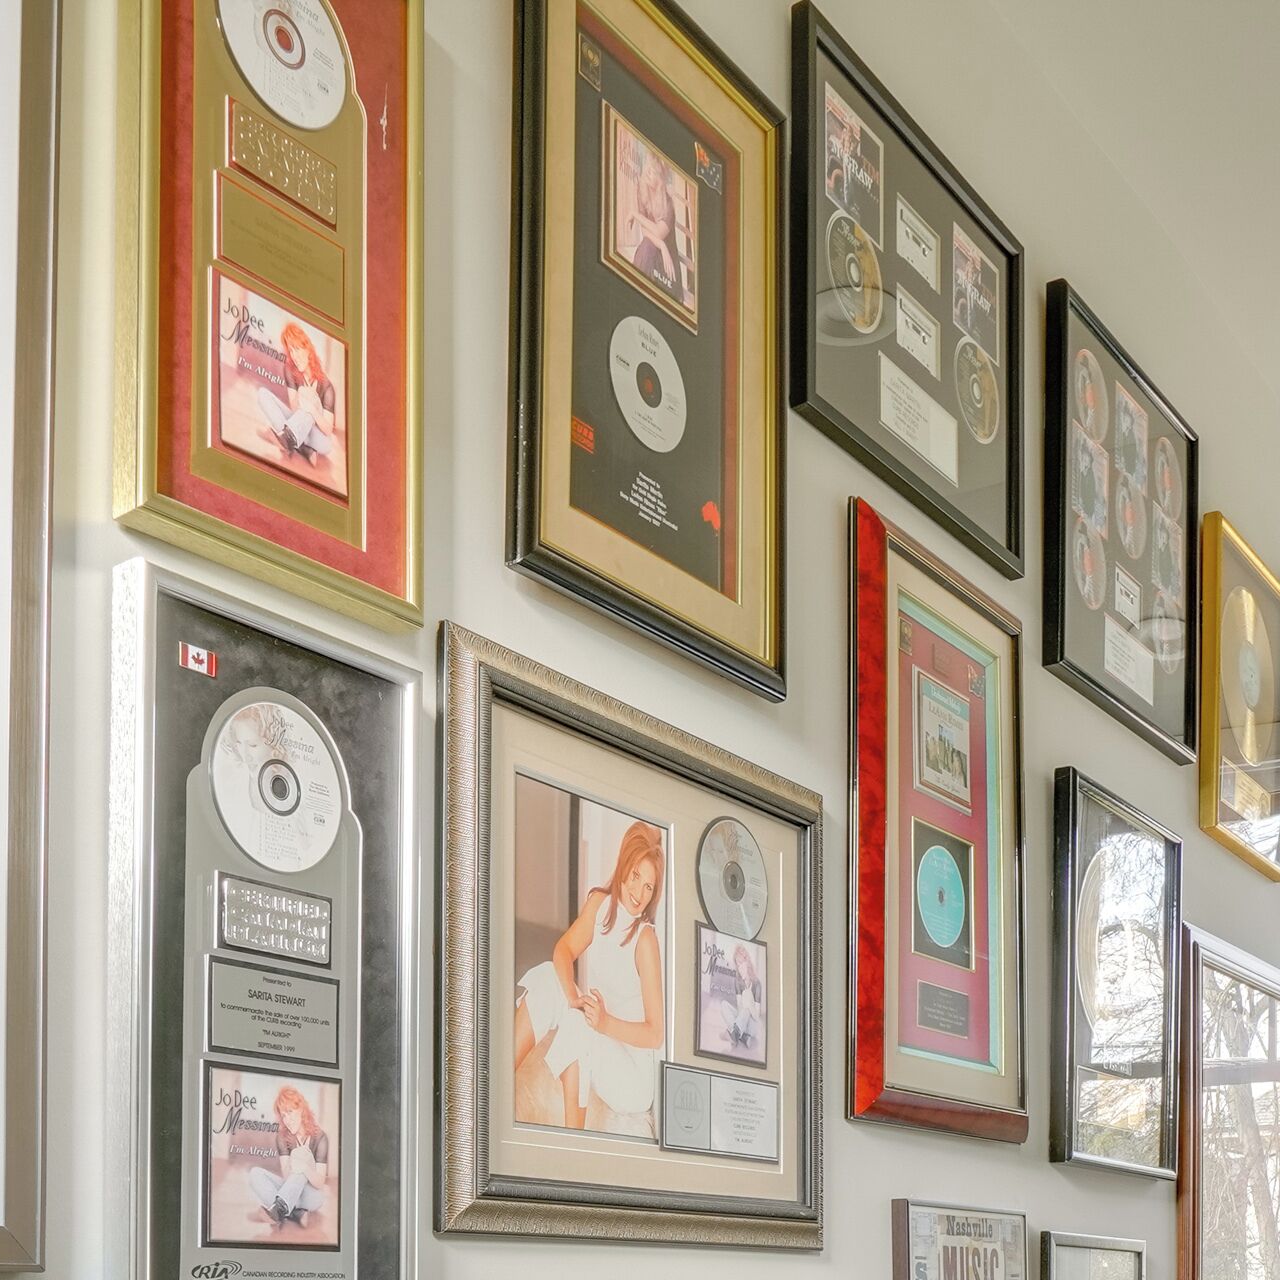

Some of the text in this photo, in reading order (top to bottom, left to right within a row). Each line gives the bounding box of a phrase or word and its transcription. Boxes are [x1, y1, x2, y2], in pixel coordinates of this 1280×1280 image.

[653, 269, 672, 288] BLUE
[224, 298, 264, 333] Jo Dee
[221, 321, 287, 364] Messina
[238, 357, 287, 386] I'm Alright
[264, 726, 314, 754] Messina
[248, 989, 306, 1007] SARITA STEWART
[215, 1088, 257, 1110] Jo Dee
[213, 1107, 279, 1135] Messina
[230, 1144, 278, 1158] I'm Alright
[946, 1215, 993, 1238] Nashville
